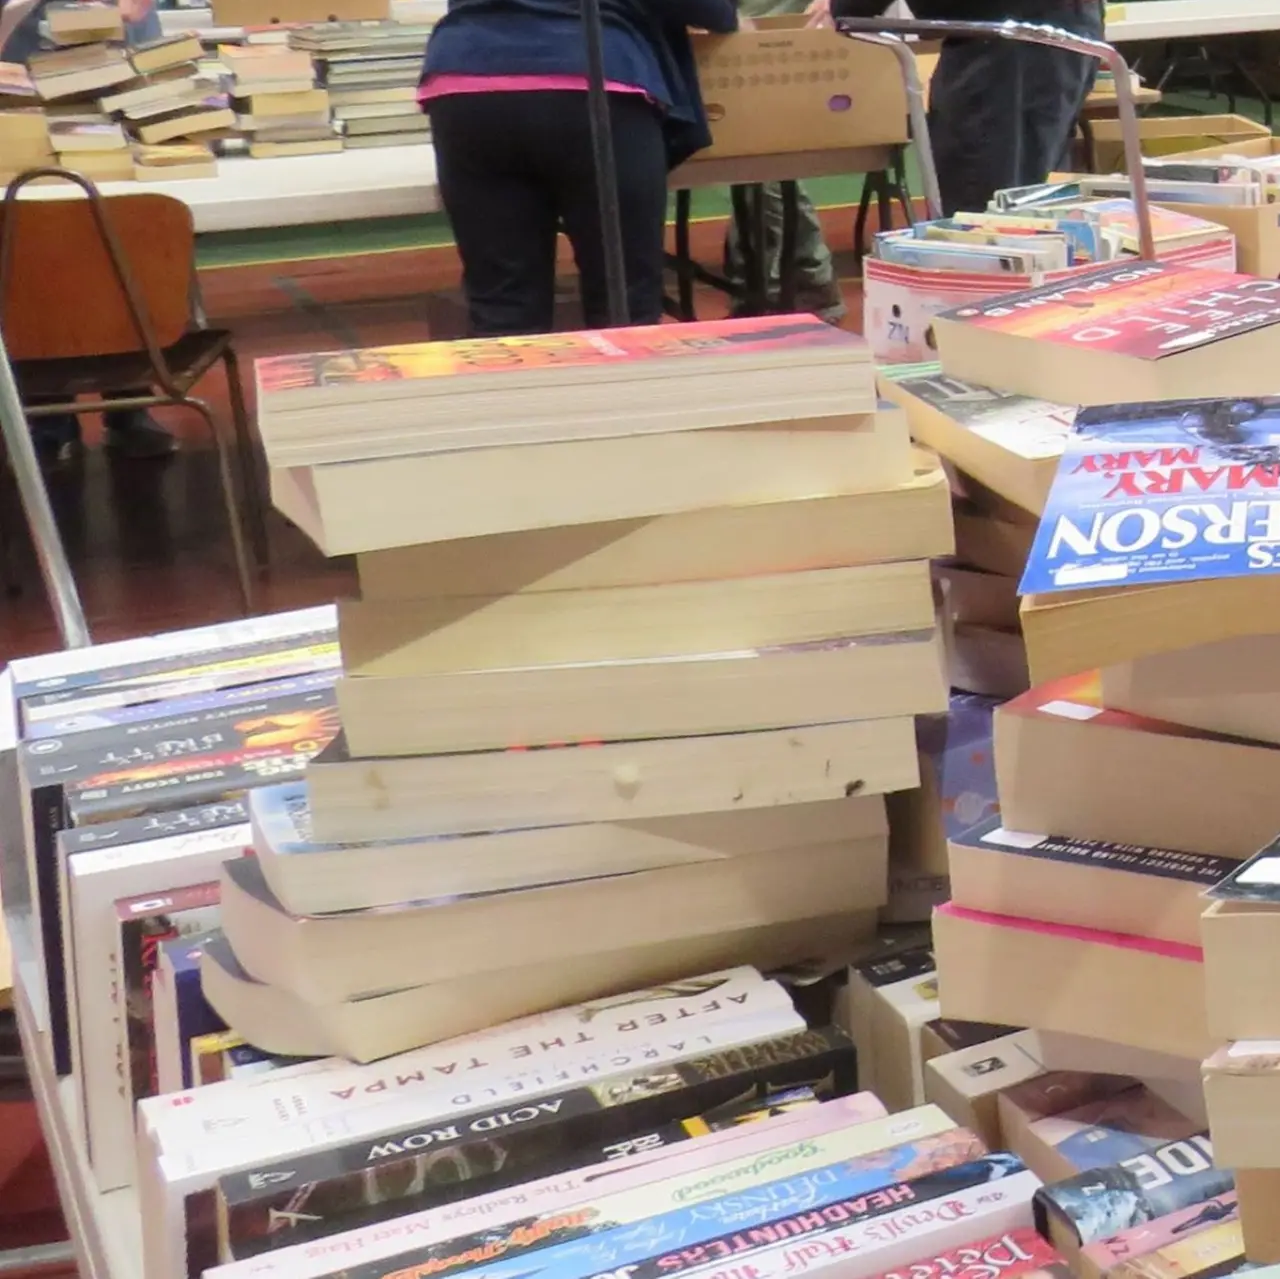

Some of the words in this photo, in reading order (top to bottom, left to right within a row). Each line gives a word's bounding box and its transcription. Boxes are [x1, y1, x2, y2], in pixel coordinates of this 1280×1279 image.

[1113, 266, 1163, 287] NO
[1014, 280, 1102, 312] PLAN
[1071, 447, 1200, 475] MARY
[614, 992, 749, 1033] AFTER
[507, 1031, 595, 1060] THE
[328, 1056, 489, 1101] TAMPA
[451, 1035, 712, 1107] LARCHFIELD
[468, 1099, 564, 1134] ACID
[366, 1124, 463, 1162] ROW
[689, 1167, 839, 1224] DELINSKY
[655, 1182, 916, 1273] HEADHUNTERS
